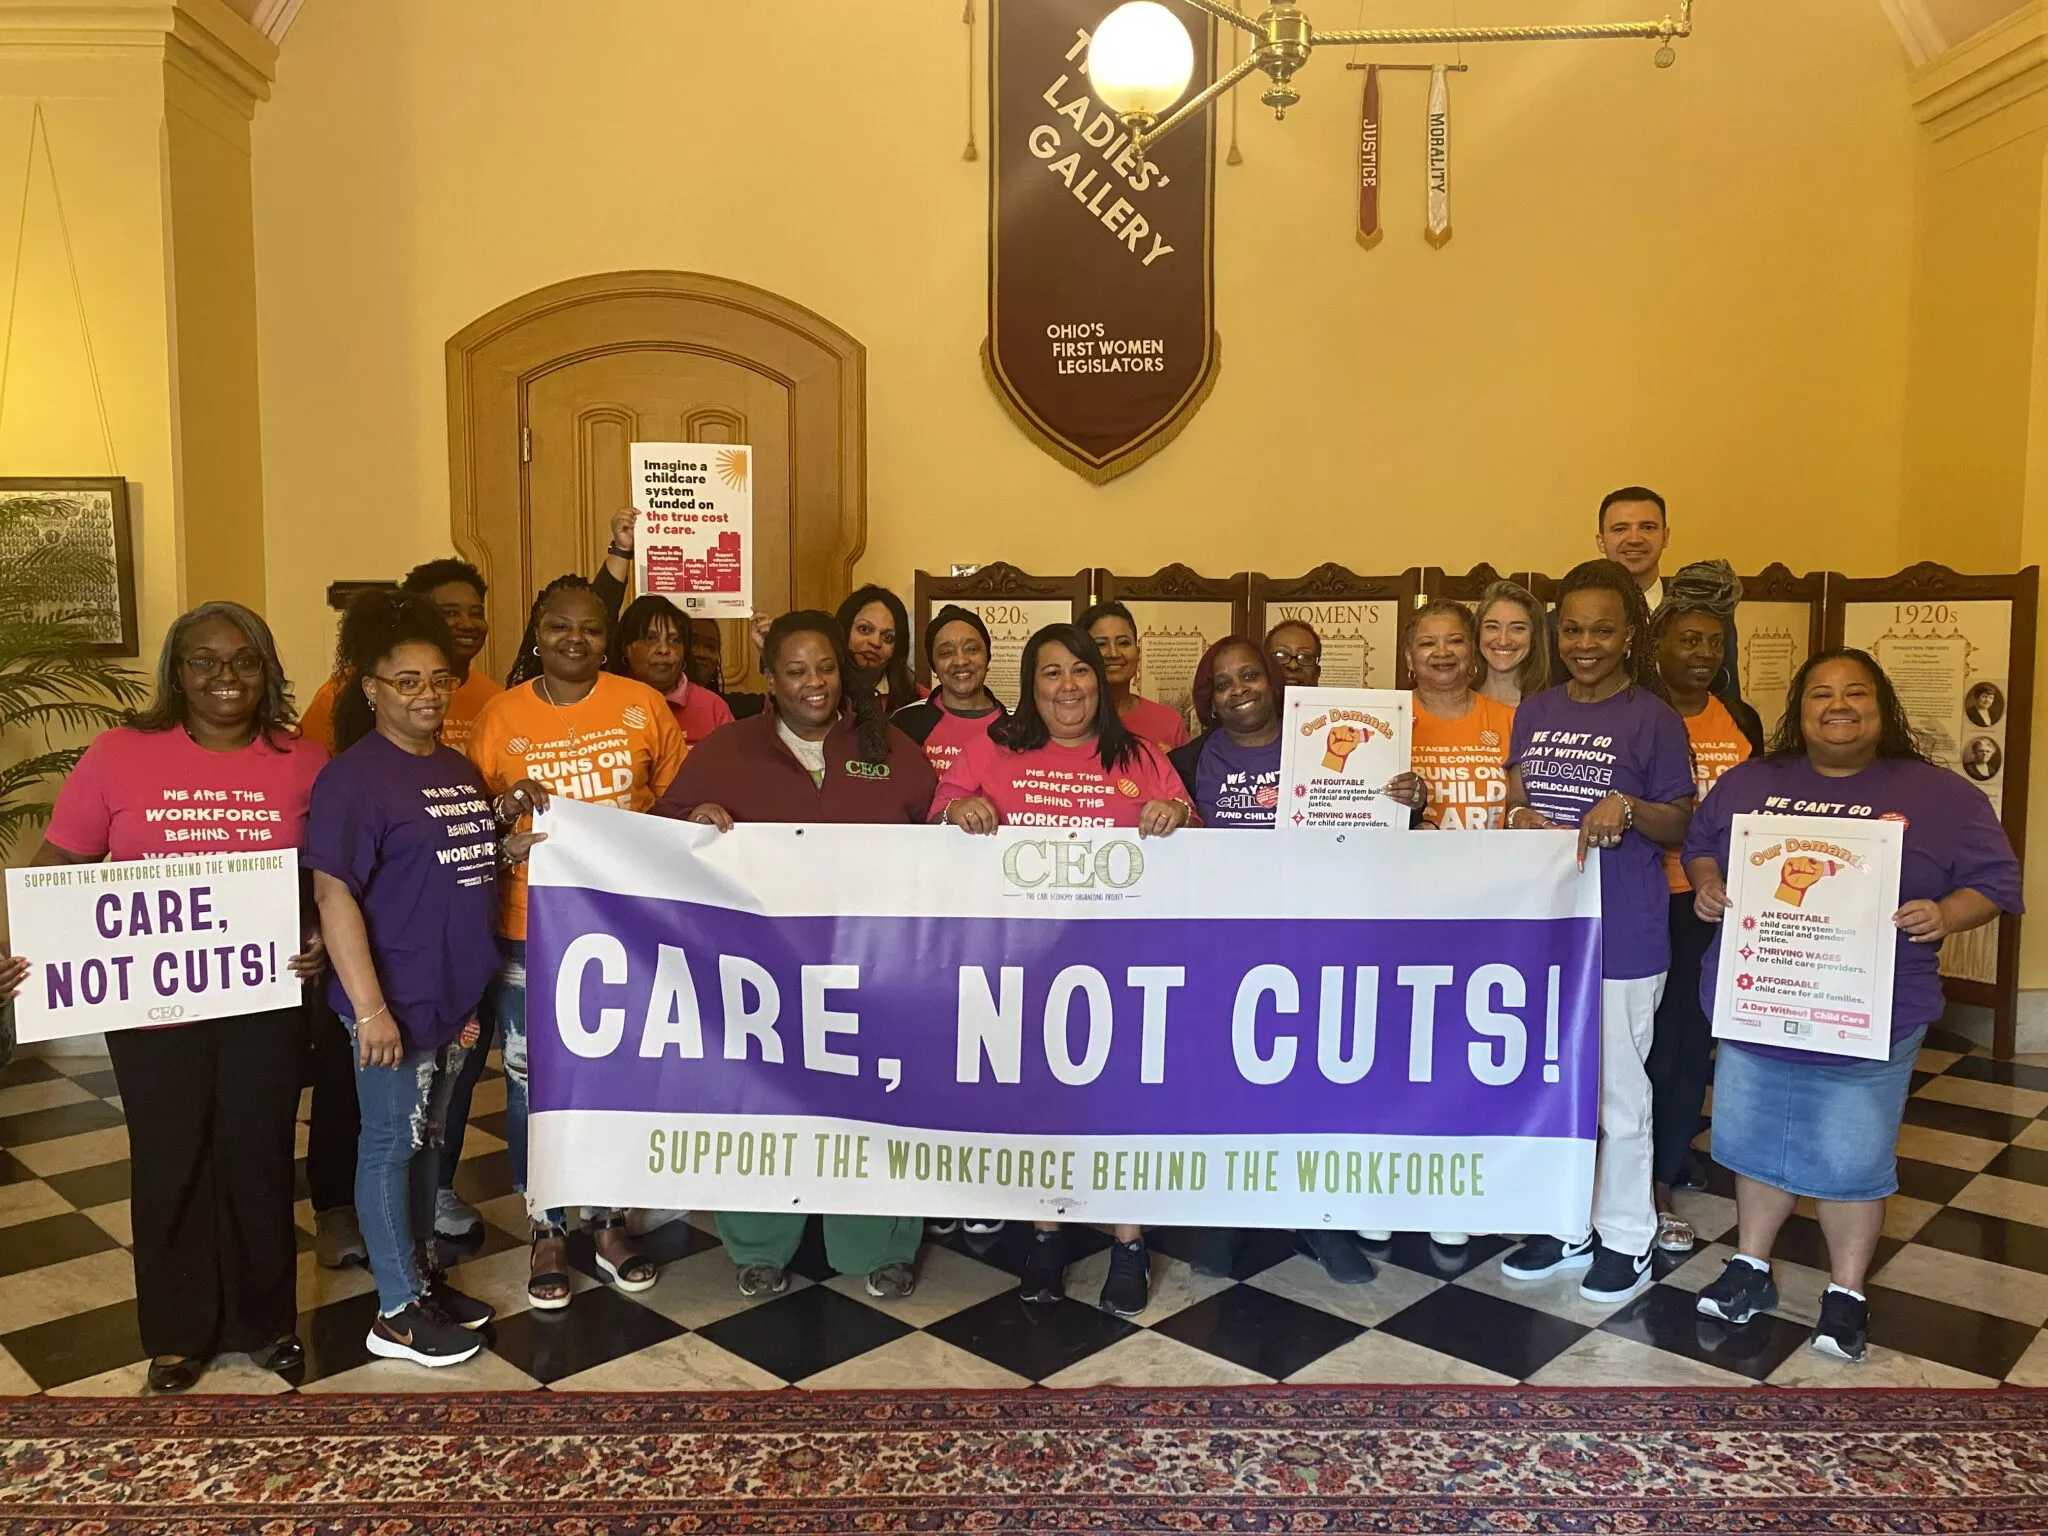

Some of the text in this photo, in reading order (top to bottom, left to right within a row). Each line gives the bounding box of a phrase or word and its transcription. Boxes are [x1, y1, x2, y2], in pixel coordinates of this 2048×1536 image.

[1043, 74, 1170, 191] LADIES'
[1362, 119, 1377, 187] JUSTICE
[1430, 113, 1446, 193] MORALITY
[1028, 125, 1175, 266] GALLERY
[1047, 323, 1105, 339] OHIO'S
[1053, 340, 1164, 358] FIRST WOMEN
[1058, 357, 1164, 374] LEGISLATORS
[644, 459, 708, 473] Imagine a
[645, 472, 706, 484] childcare
[645, 486, 694, 498] system
[649, 498, 714, 510] funded on
[646, 511, 729, 523] the true cost
[647, 524, 696, 535] of care.
[1278, 605, 1379, 624] WOMEN'S
[1893, 604, 1958, 625] 1920s
[1301, 709, 1394, 740] Our Demands
[1531, 731, 1551, 743] WE
[1592, 736, 1612, 748] GO
[524, 738, 629, 762] OUR ECONOMY
[927, 745, 943, 754] WE
[1527, 747, 1554, 757] DAY
[1554, 748, 1616, 764] WITHOUT
[526, 750, 632, 781] RUNS ON
[1411, 755, 1502, 764] OUR ECONOMY
[845, 760, 890, 778] CEO
[1025, 769, 1104, 782] WE ARE THE
[1412, 766, 1506, 780] RUNS ON
[1521, 760, 1613, 786] CHILDCARE
[1227, 771, 1247, 784] WE
[421, 785, 478, 799] WE ARE THE
[1011, 779, 1116, 795] WORKFORCE
[1220, 783, 1228, 794] A
[1580, 786, 1607, 798] NOW!
[163, 789, 266, 802] WE ARE THE
[1025, 793, 1105, 809] BEHIND THE
[1765, 796, 1790, 809] WE
[1793, 799, 1845, 815] CAN'T
[1848, 804, 1872, 817] GO
[145, 808, 282, 822] WORKFORCE
[1007, 812, 1116, 828] WORKFORCE
[1215, 811, 1242, 820] FUND
[446, 821, 481, 837] BEHIND
[1353, 820, 1390, 828] providers.
[164, 828, 272, 842] BEHIND THE
[1002, 838, 1145, 890] CEO
[1750, 838, 1873, 876] Our Demands
[24, 871, 73, 888] SUPPORT
[77, 869, 96, 884] THE
[100, 865, 161, 883] WORKFORCE
[166, 862, 202, 878] BEHIND
[205, 859, 224, 875] THE
[228, 855, 284, 874] WORKFORCE
[1026, 892, 1034, 900] THE
[95, 886, 228, 939] CARE,
[1776, 912, 1830, 924] EQUITABLE
[1759, 928, 1846, 942] on racial and gender
[1760, 920, 1857, 936] child care system built
[1758, 934, 1789, 944] justice.
[1758, 947, 1842, 962] THRIVING WAGES
[1756, 955, 1866, 974] for child care providers.
[45, 941, 277, 1010] NOT CUTS!
[1755, 975, 1820, 990] AFFORDABLE
[1754, 985, 1865, 1004] child care for all families.
[147, 1004, 184, 1020] CEO
[555, 932, 1560, 1094] CARE, NOT CUTS!
[1742, 1002, 1866, 1025] A Day Without Child Care
[648, 1128, 1486, 1197] SUPPORT THE WORKFORCE BEHIND THE WORKFORCE
